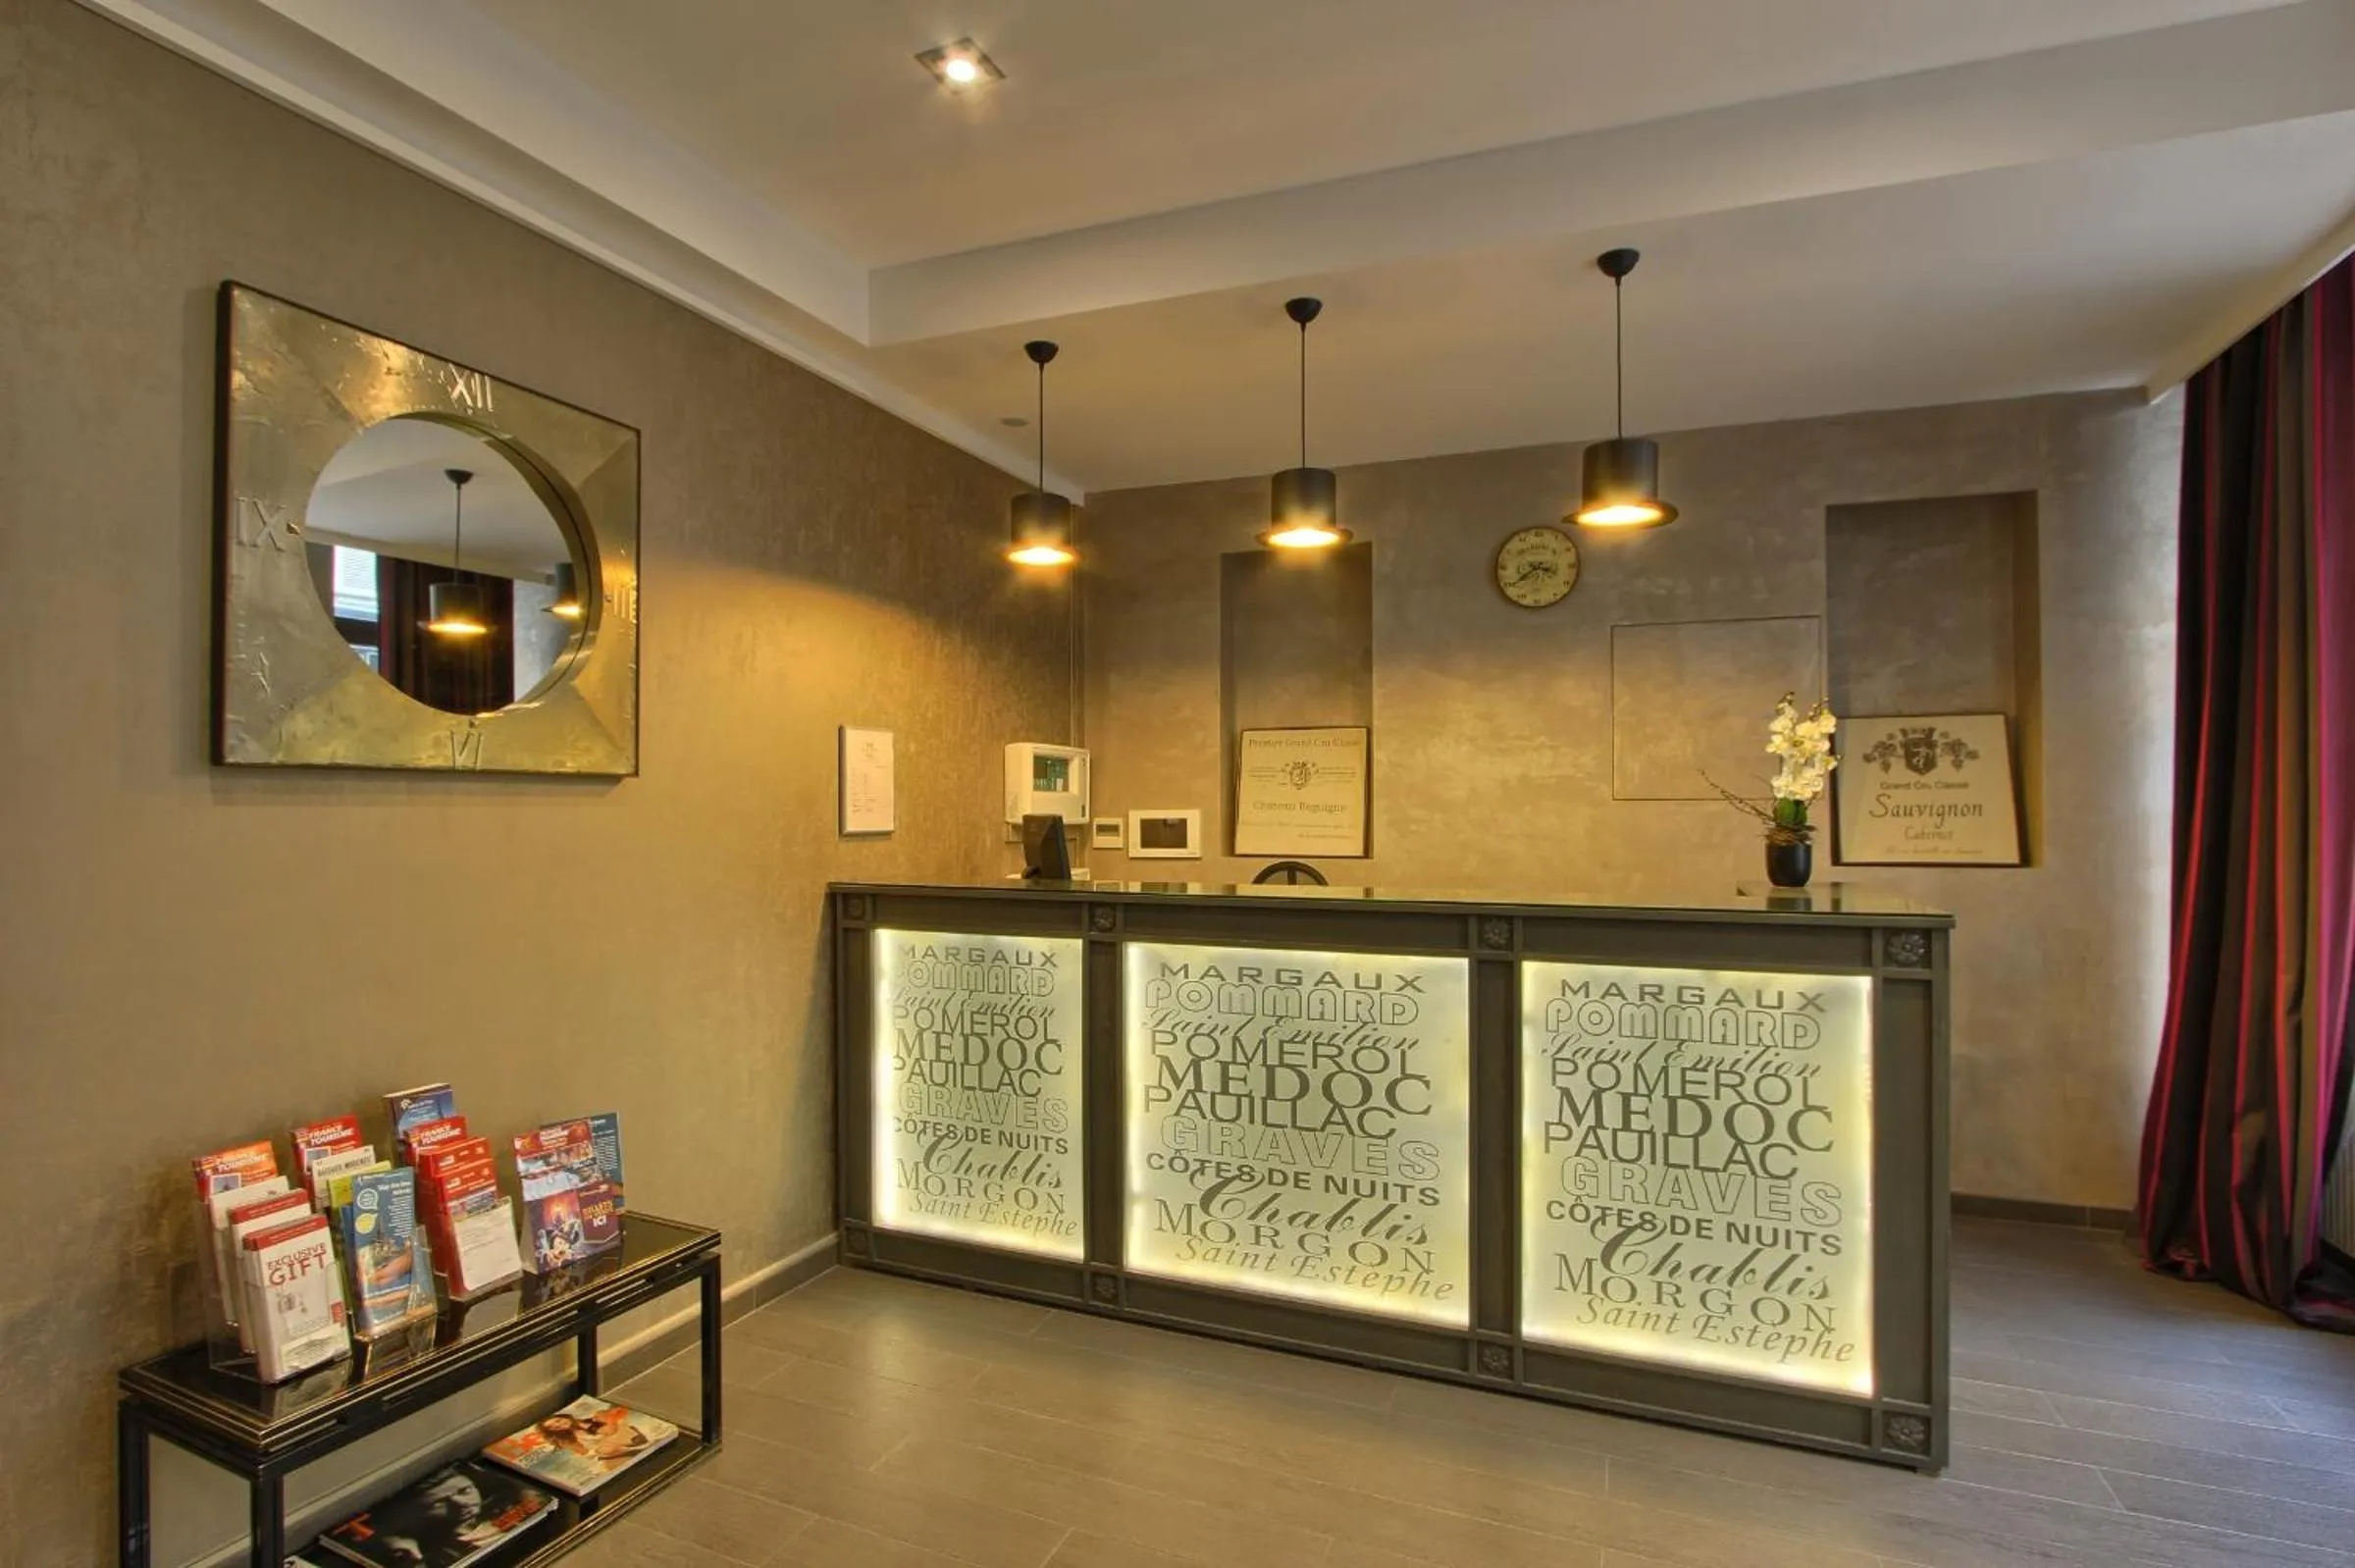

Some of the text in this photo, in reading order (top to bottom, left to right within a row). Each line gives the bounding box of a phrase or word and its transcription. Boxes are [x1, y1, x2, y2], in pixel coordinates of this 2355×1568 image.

[1868, 793, 1983, 829] Sauvignon
[1145, 978, 1419, 1025] POMMARD
[1160, 963, 1427, 994] MARGAUX
[1560, 979, 1829, 1013] MARGAUX
[894, 1005, 1059, 1042] POMEROL
[1545, 997, 1821, 1050] POMMARD
[895, 1029, 1063, 1075] MEDOC
[1151, 1029, 1428, 1079] POMEROL
[898, 1081, 1069, 1133] GRAVES
[1155, 1054, 1433, 1116] MEDOC
[1551, 1058, 1829, 1111] POMEROL
[1144, 1084, 1397, 1140] PAUILLAC
[1557, 1086, 1834, 1152] MEDOC
[916, 1126, 1062, 1189] Chablis
[965, 1126, 992, 1145] DE
[999, 1129, 1069, 1155] NUITS
[1161, 1114, 1440, 1181] GRAVES
[1544, 1121, 1799, 1179] PAUILLAC
[897, 1158, 1066, 1215] MORGON
[1189, 1168, 1430, 1246] Chablis
[1268, 1168, 1313, 1191] DE
[1324, 1174, 1440, 1207] NUITS
[1561, 1155, 1843, 1227] GRAVES
[1154, 1198, 1439, 1275] MORGON
[1545, 1196, 1843, 1256] CÔTES DE NUITS
[267, 1242, 328, 1272] EXCLUSIVE
[268, 1251, 328, 1286] GIFT
[1176, 1236, 1279, 1274] Saint
[1590, 1213, 1830, 1301] Chablis
[1553, 1253, 1836, 1333] MORGON
[1577, 1293, 1681, 1335] Saint
